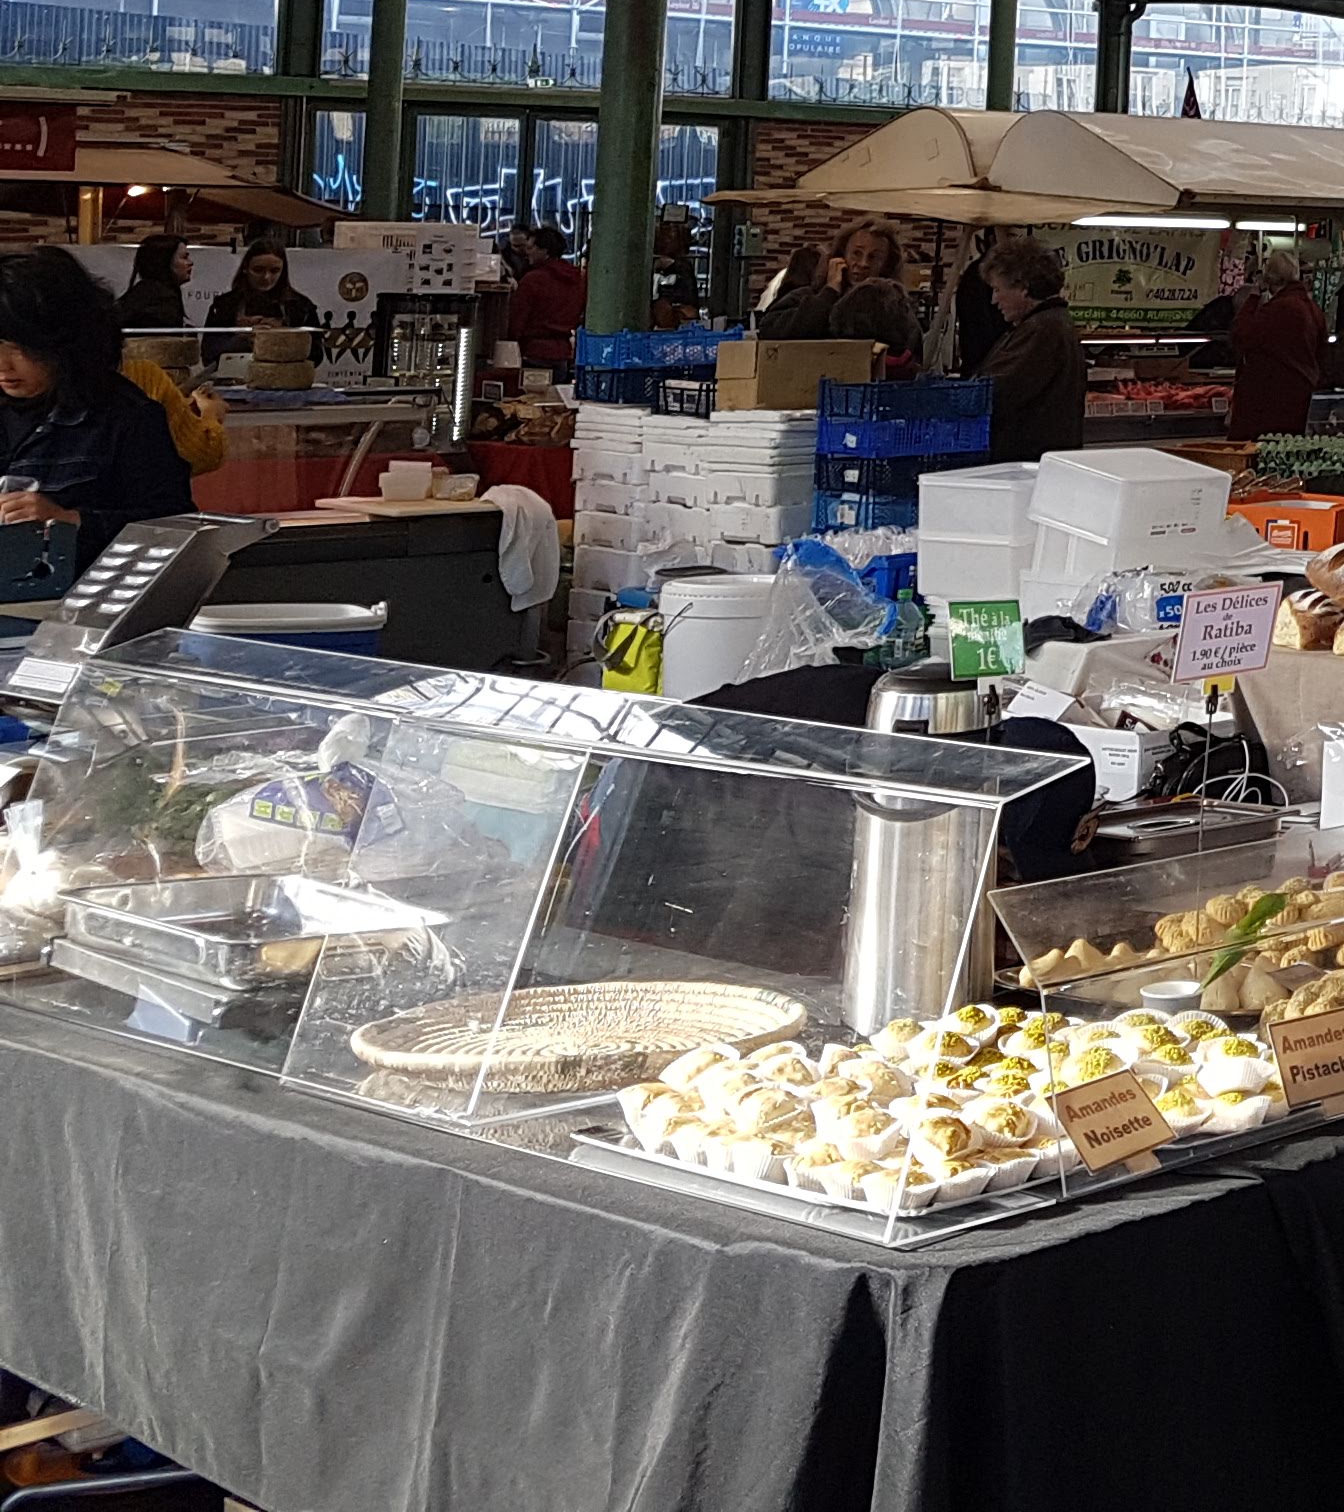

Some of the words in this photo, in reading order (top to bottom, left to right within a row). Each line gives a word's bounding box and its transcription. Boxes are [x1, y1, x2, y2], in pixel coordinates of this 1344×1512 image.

[791, 34, 841, 43] ANQUE
[788, 44, 841, 54] OPULAIRE
[1076, 238, 1196, 277] GRIGNO'LAP
[1195, 601, 1218, 615] Les
[1221, 595, 1269, 611] Délices
[959, 608, 989, 628] Thé
[992, 612, 998, 626] à
[1000, 611, 1011, 626] la
[1222, 613, 1233, 621] de
[1201, 620, 1253, 642] Ratiba
[1201, 662, 1214, 671] au
[1215, 656, 1241, 669] choix
[1065, 1089, 1137, 1123] Amandes
[1083, 1114, 1153, 1148] Noisette
